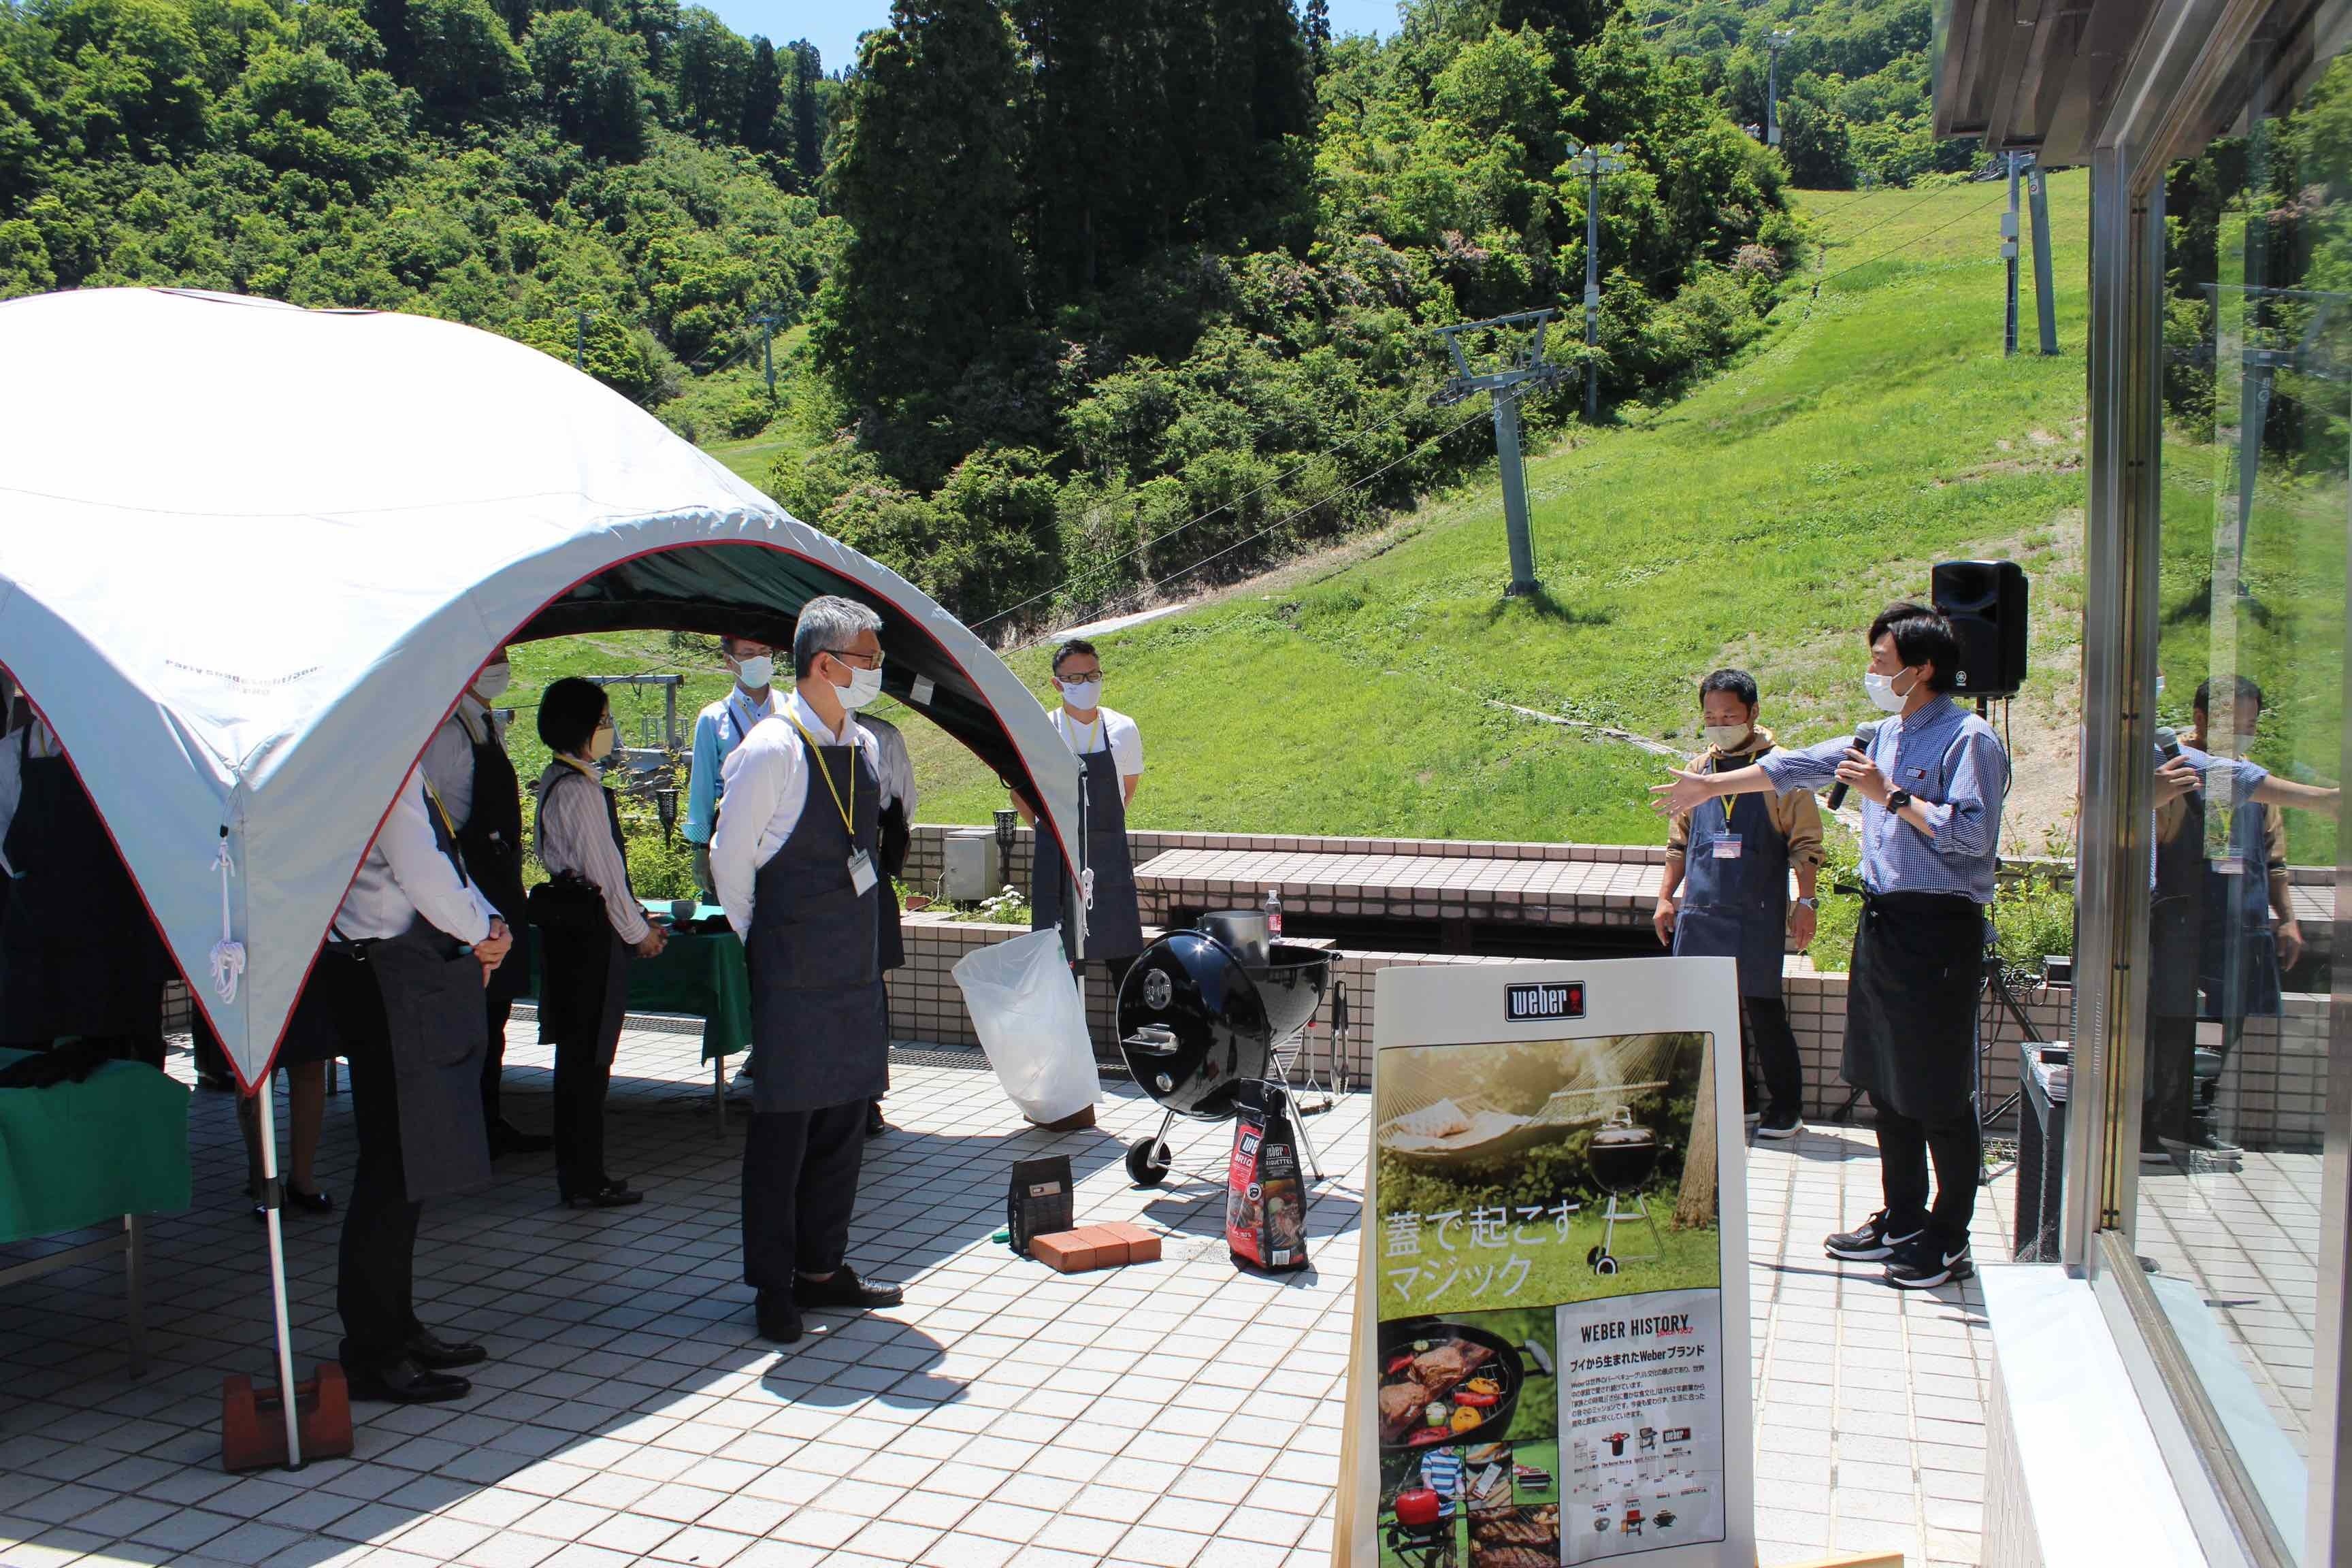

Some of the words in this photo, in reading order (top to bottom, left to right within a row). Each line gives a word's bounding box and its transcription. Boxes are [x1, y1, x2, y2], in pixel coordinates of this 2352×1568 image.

[1512, 984, 1567, 1015] weber
[1386, 1199, 1580, 1257] 蓋で起こす
[1387, 1253, 1531, 1301] マジック
[1581, 1321, 1625, 1343] WEBER
[1631, 1314, 1688, 1337] HISTORY
